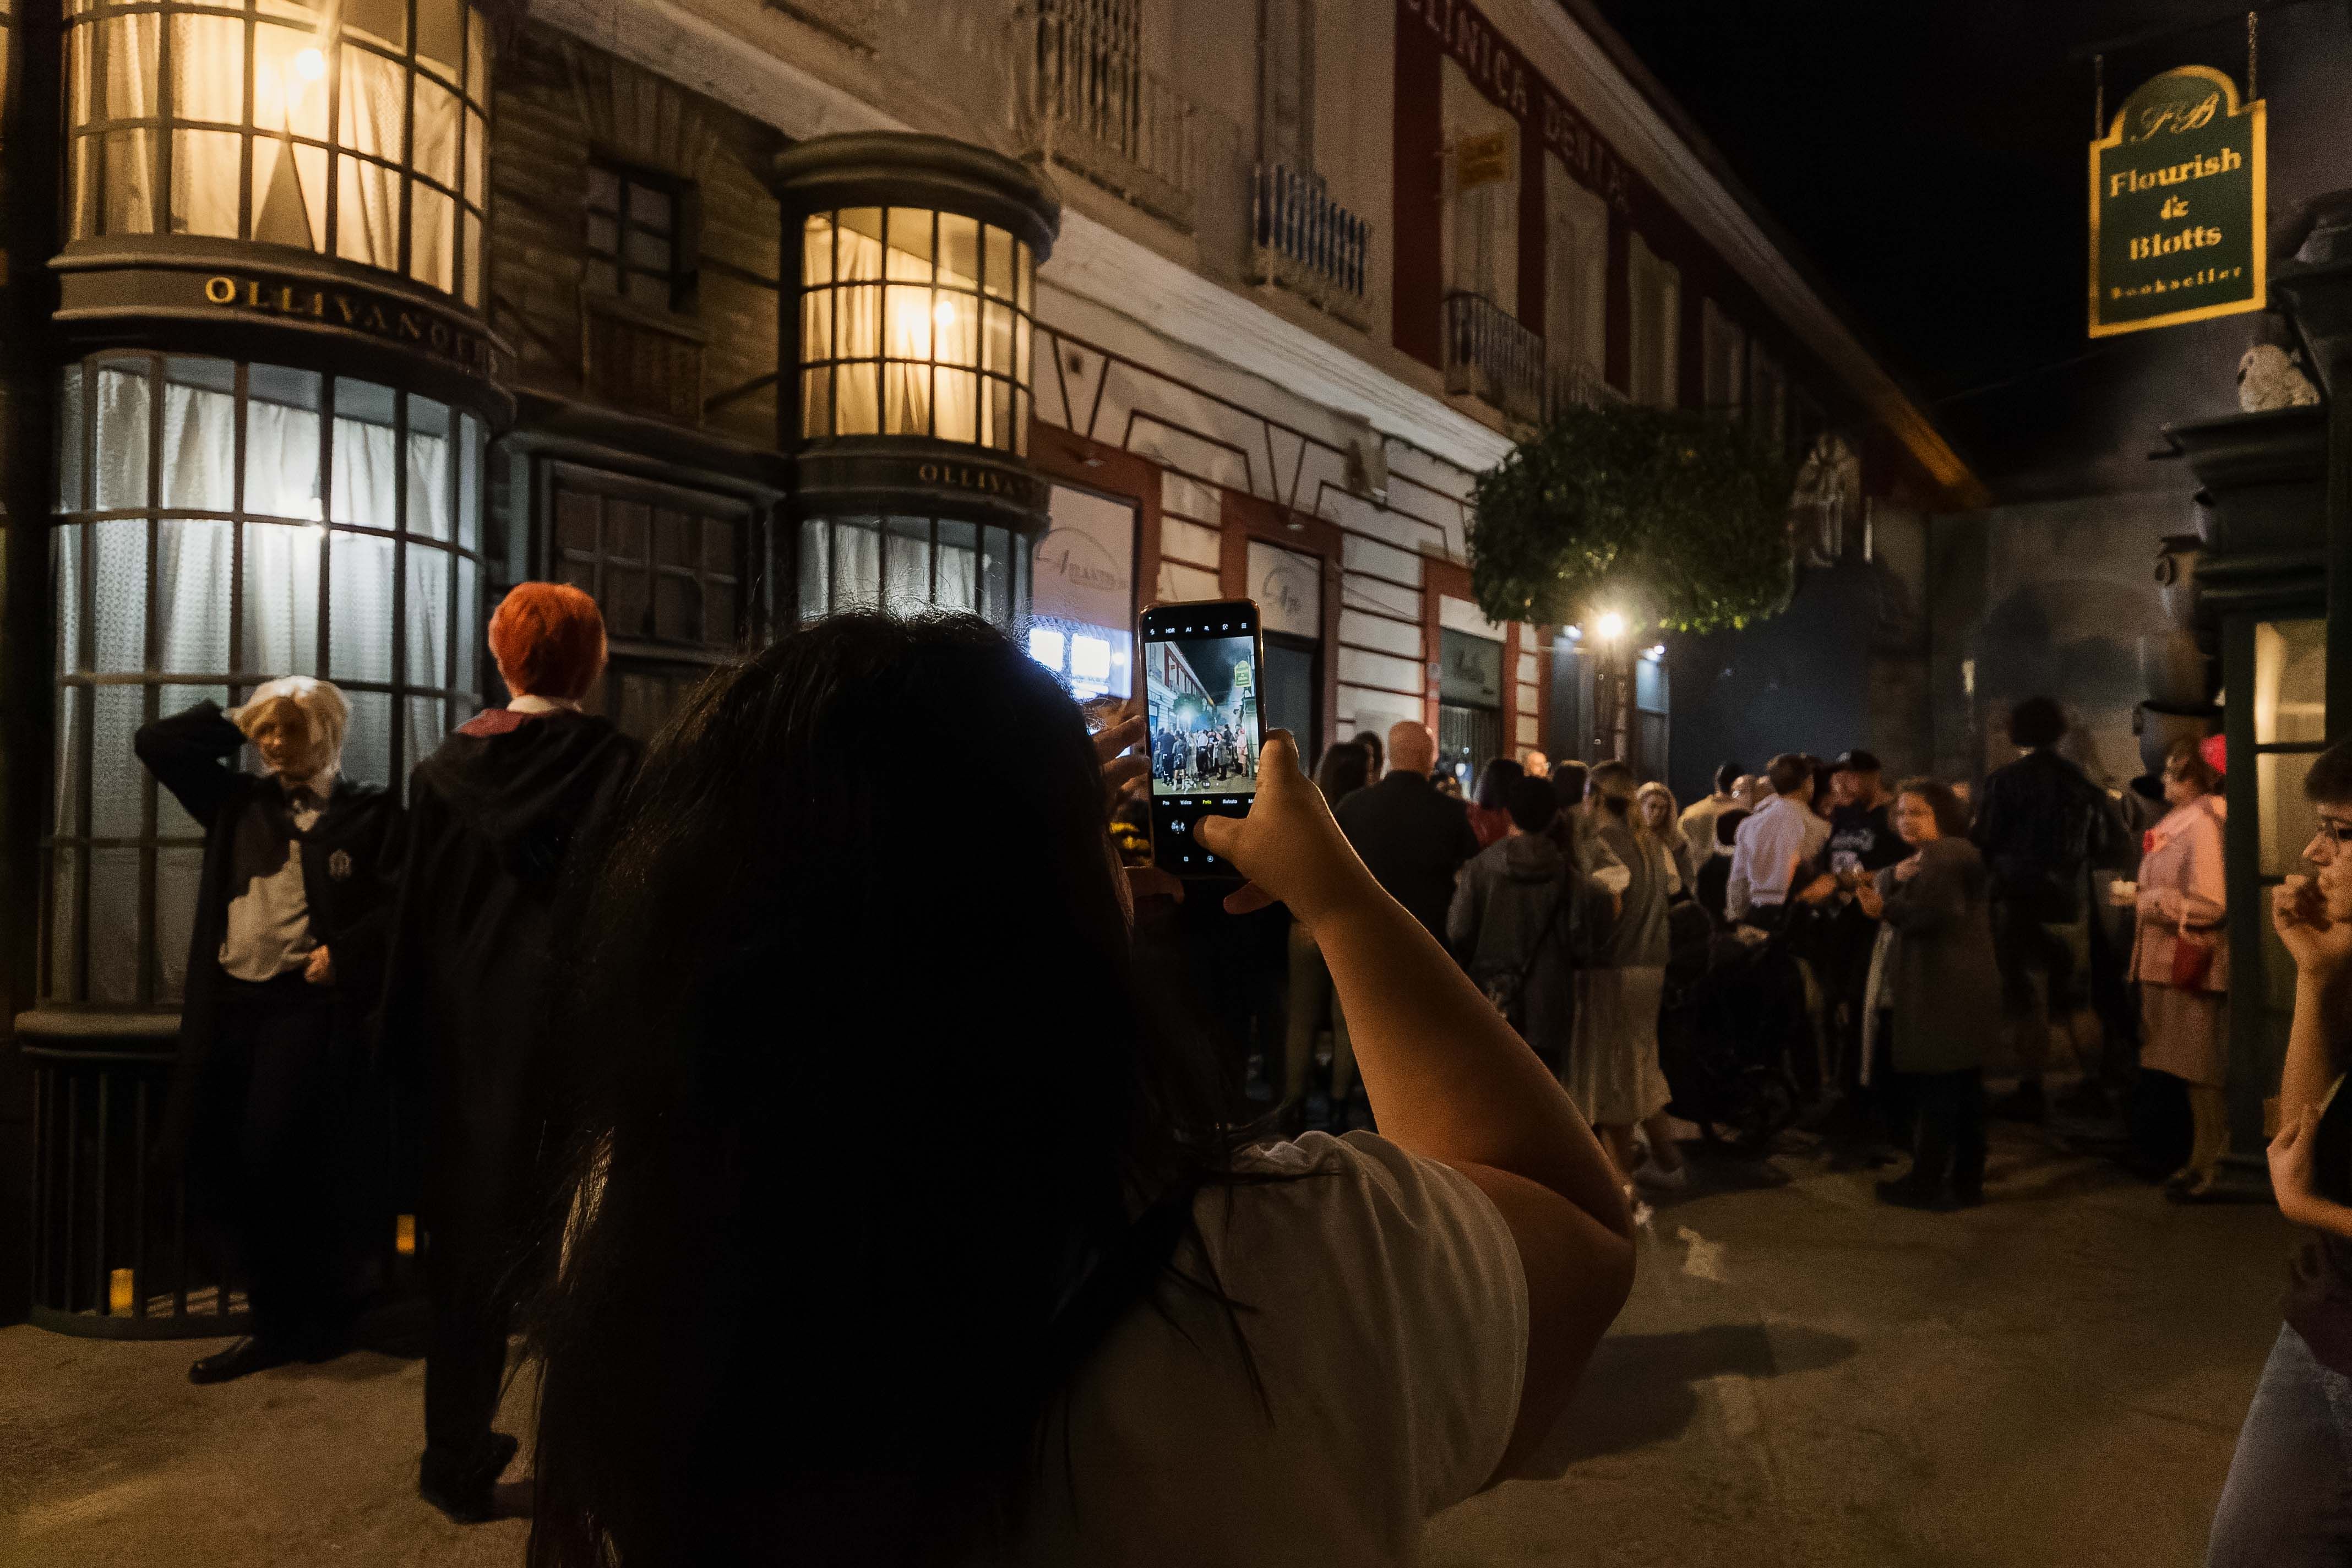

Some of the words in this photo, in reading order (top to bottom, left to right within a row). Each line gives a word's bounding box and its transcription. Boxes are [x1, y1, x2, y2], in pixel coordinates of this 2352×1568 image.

[1407, 0, 1528, 116] LINICA
[2110, 147, 2241, 197] Flourish
[2128, 225, 2222, 260] Blotts
